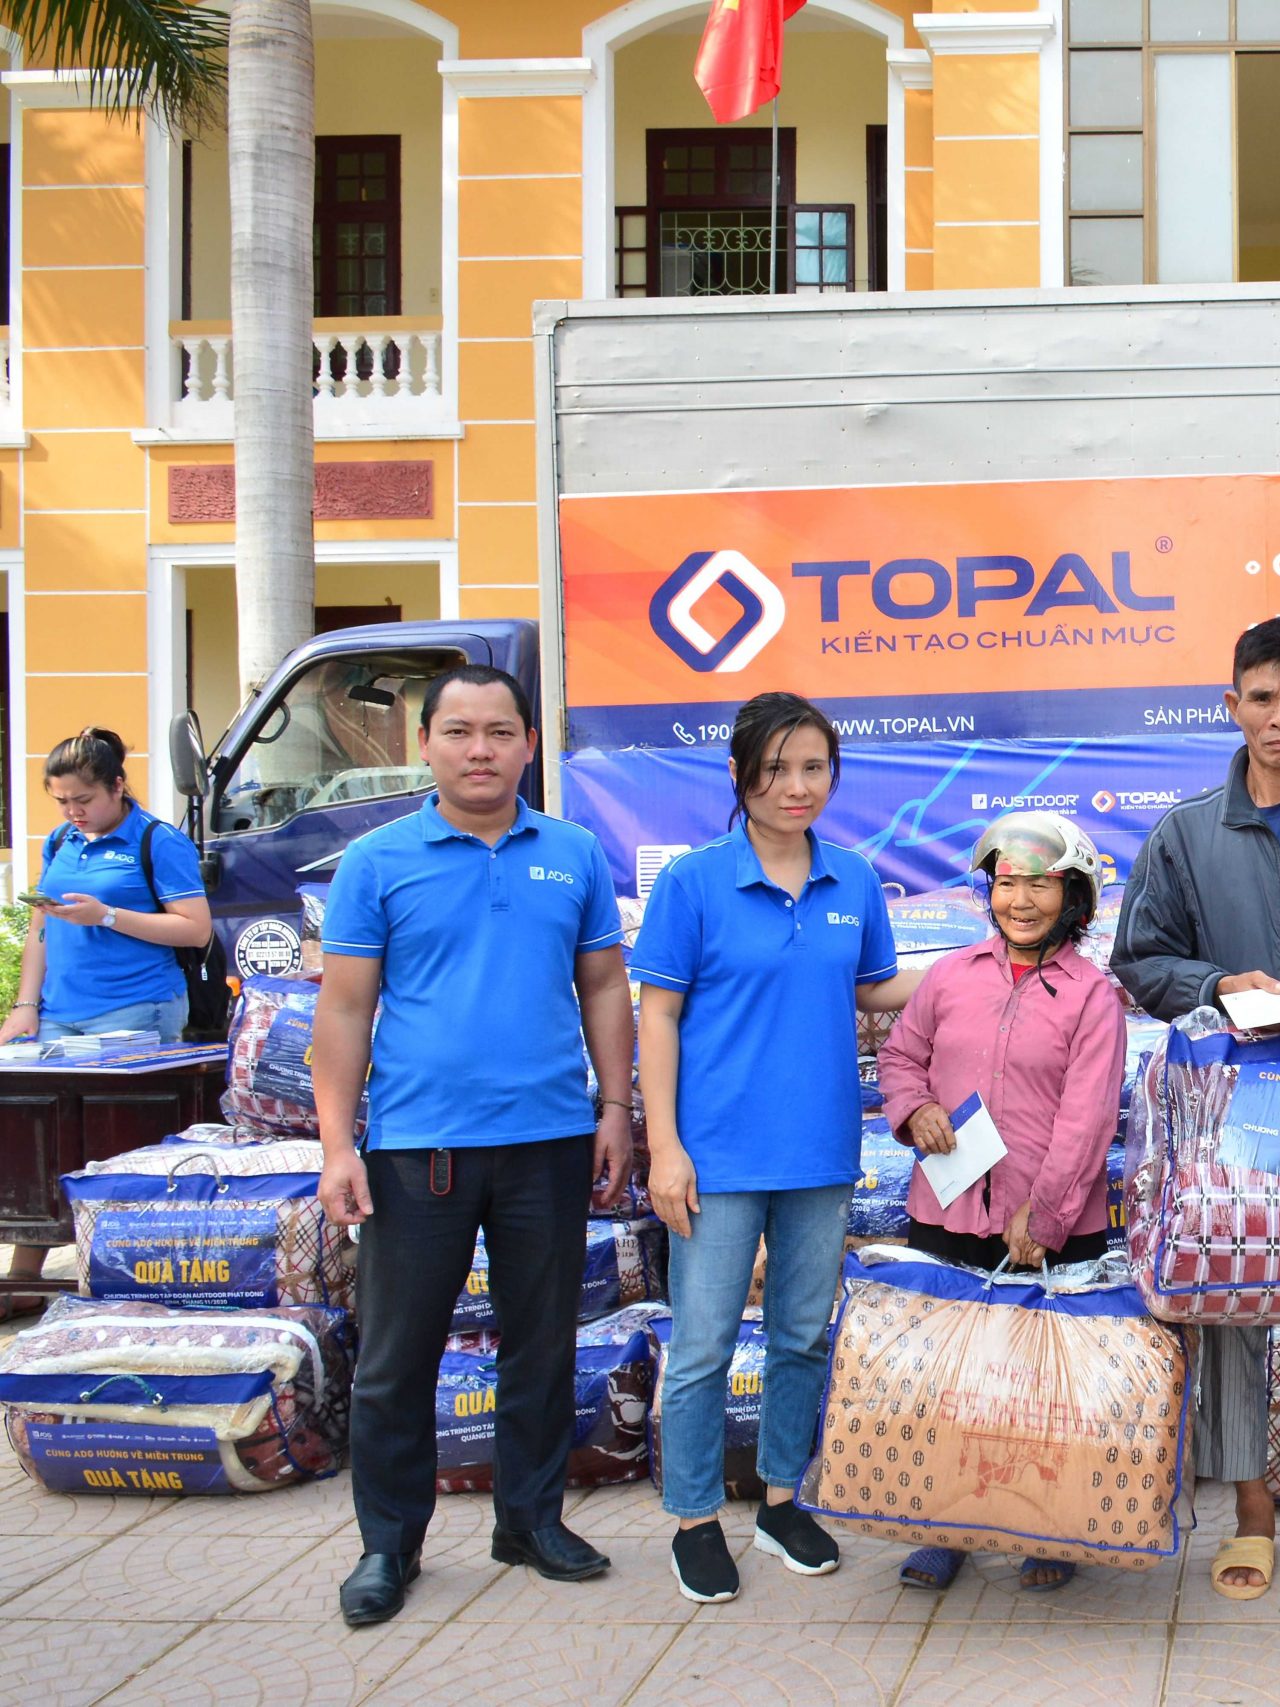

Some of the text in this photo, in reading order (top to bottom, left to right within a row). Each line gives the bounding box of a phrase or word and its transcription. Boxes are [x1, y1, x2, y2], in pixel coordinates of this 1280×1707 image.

[792, 552, 1175, 623] TOPAL
[821, 623, 1175, 654] KIẾN TẠO CHUẨN MỰC
[1144, 704, 1182, 725] SẢN
[1186, 703, 1232, 723] PHẨ
[990, 794, 1079, 809] AUSTDOOR
[1116, 791, 1181, 804] TOPAL
[547, 869, 574, 885] ADG
[841, 914, 860, 927] ADG
[135, 1256, 230, 1287] QUÀ TẶNG
[471, 1423, 483, 1433] DO
[45, 1448, 71, 1458] CÙNG
[74, 1449, 94, 1459] ADG
[131, 1449, 144, 1460] VỀ
[145, 1450, 169, 1461] MIỀN
[171, 1451, 204, 1462] TRUNG
[82, 1467, 127, 1488] QUÀ
